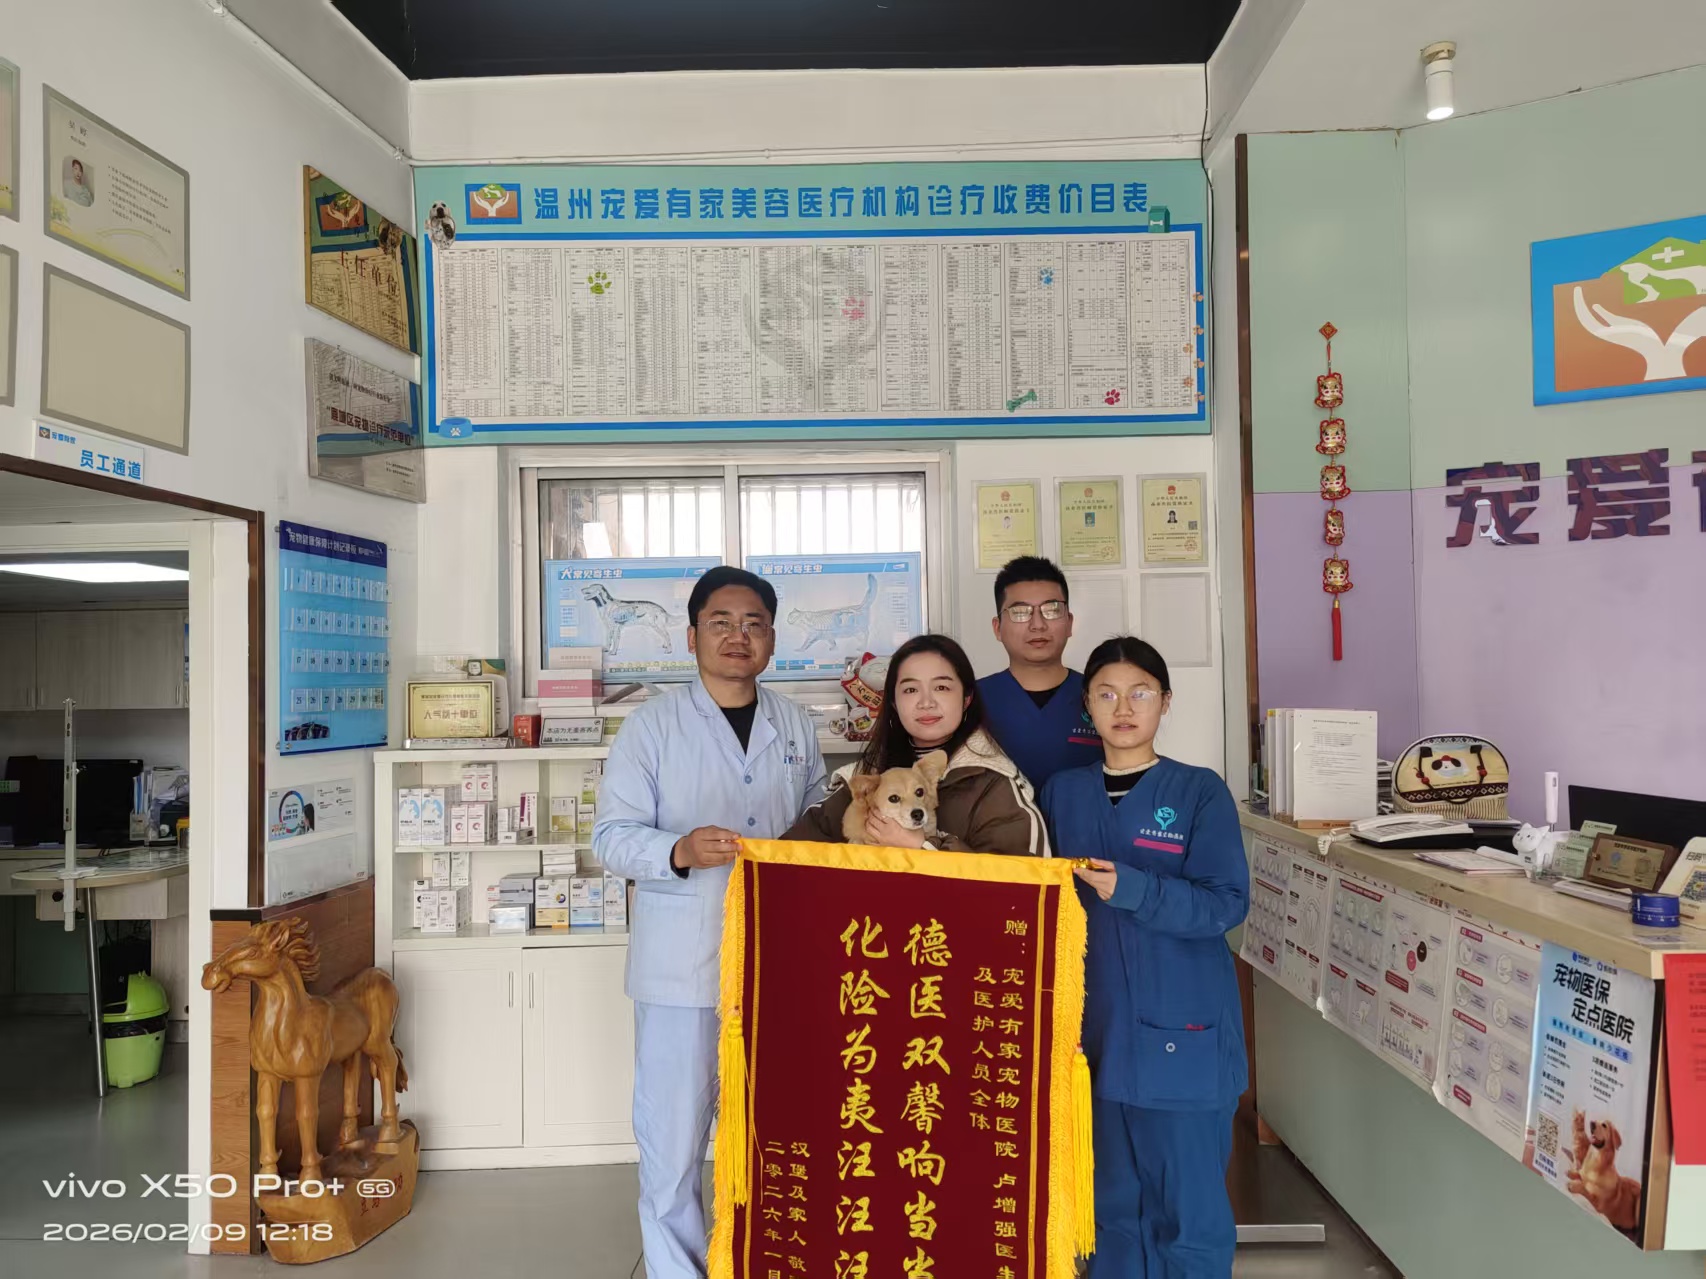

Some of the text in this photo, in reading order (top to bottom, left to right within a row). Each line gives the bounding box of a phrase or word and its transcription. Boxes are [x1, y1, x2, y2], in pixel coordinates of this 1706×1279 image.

[533, 182, 1148, 220] 温州宠爱有家美容医疗机构诊疗收费价目表
[80, 449, 142, 480] 员工通道
[1445, 447, 1706, 548] 宠爱
[1552, 962, 1611, 1005] 宠物医保
[1571, 997, 1635, 1044] 定点医院
[969, 966, 997, 1130] 及医护人员全体
[994, 968, 1026, 1159] 宠爱有家宠物医院
[787, 1141, 811, 1279] 汉堡及家人敬
